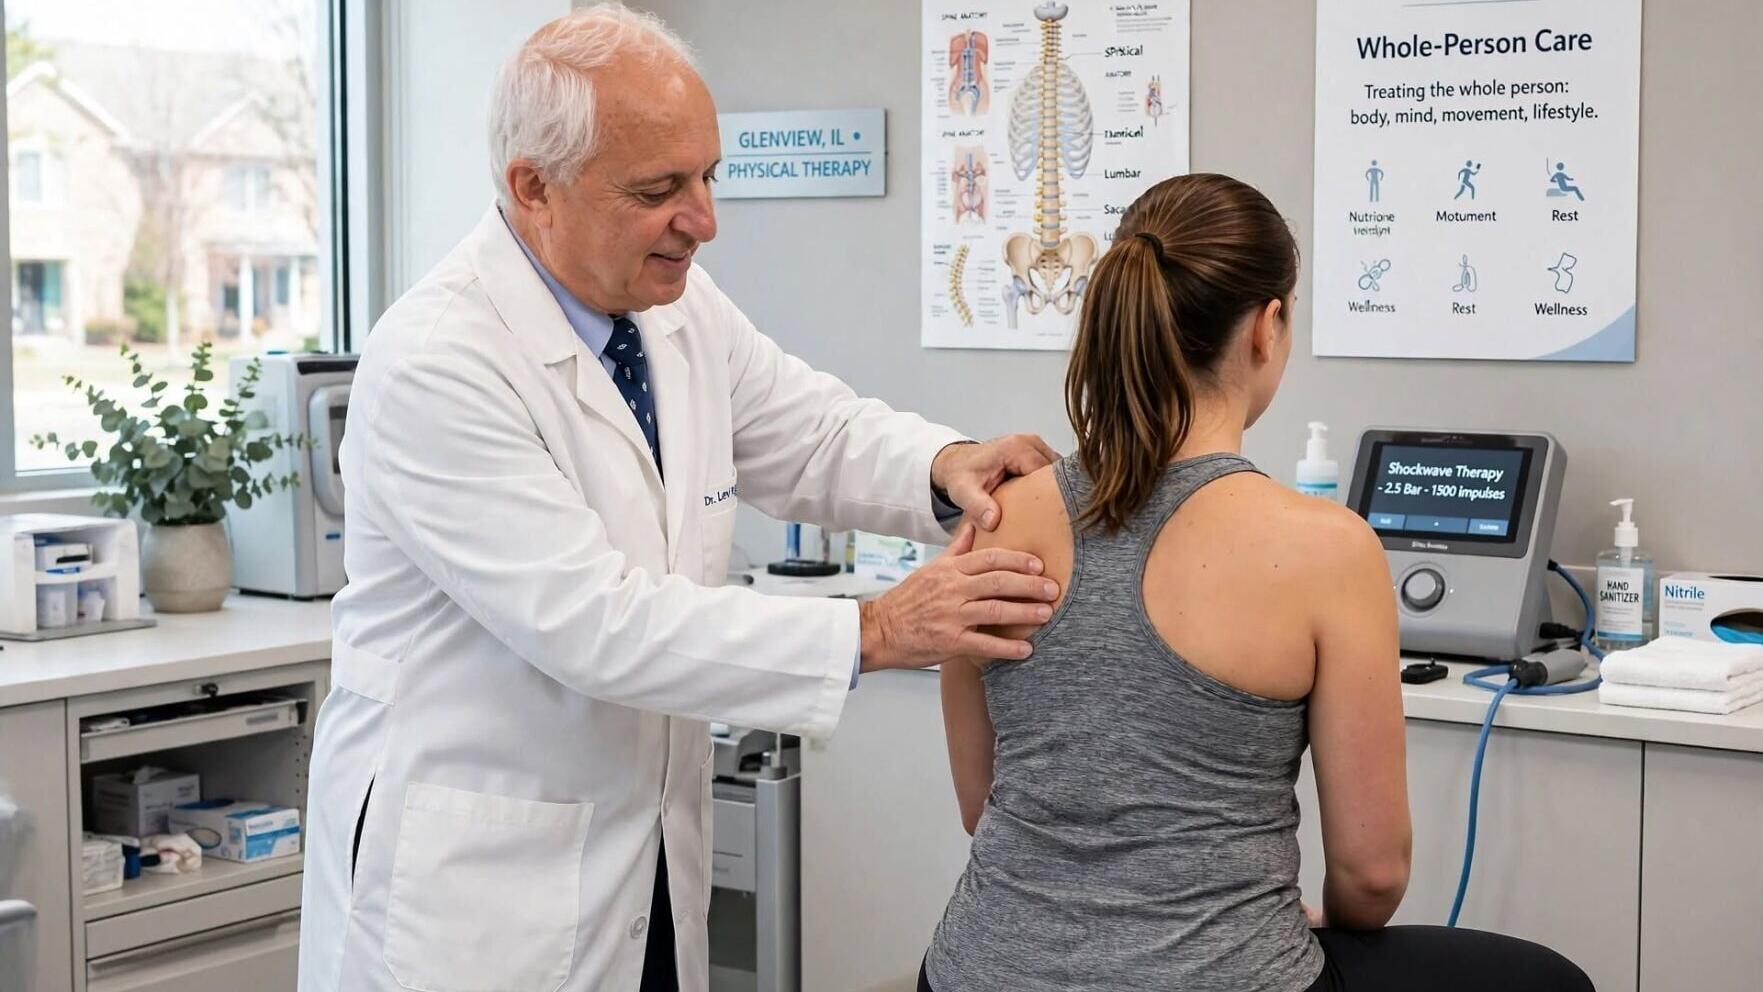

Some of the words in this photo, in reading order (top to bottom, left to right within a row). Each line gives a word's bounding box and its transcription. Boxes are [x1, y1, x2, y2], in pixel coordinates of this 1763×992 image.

[1357, 33, 1526, 59] Whole-Person
[1535, 29, 1592, 51] Care
[1365, 82, 1425, 101] Treating
[1431, 81, 1454, 97] the
[1459, 79, 1505, 96] whole
[1511, 80, 1569, 98] person:
[1350, 109, 1390, 127] body,
[1395, 107, 1437, 125] mind,
[1442, 105, 1528, 123] movement,
[1533, 102, 1599, 122] lifestyle.
[739, 129, 826, 149] GLENVIEW,
[831, 129, 844, 146] IL
[728, 161, 798, 179] PHYSICAL
[802, 160, 871, 177] THERAPY
[1104, 168, 1141, 179] Lumbar
[1436, 210, 1497, 222] Motument
[1552, 209, 1578, 221] Rest
[1348, 300, 1396, 313] Wellness
[1452, 302, 1476, 314] Rest
[1535, 303, 1588, 316] Wellness
[1388, 461, 1452, 477] Shockwave
[1456, 465, 1504, 482] Therapy
[1384, 483, 1401, 494] 2.5
[1404, 483, 1423, 496] Bar
[1432, 485, 1457, 498] 1500
[1458, 486, 1505, 501] impulses
[704, 496, 716, 506] Dr.
[1607, 580, 1629, 591] HAND
[1665, 585, 1705, 599] Nitrile
[1600, 591, 1639, 603] SANITIZER
